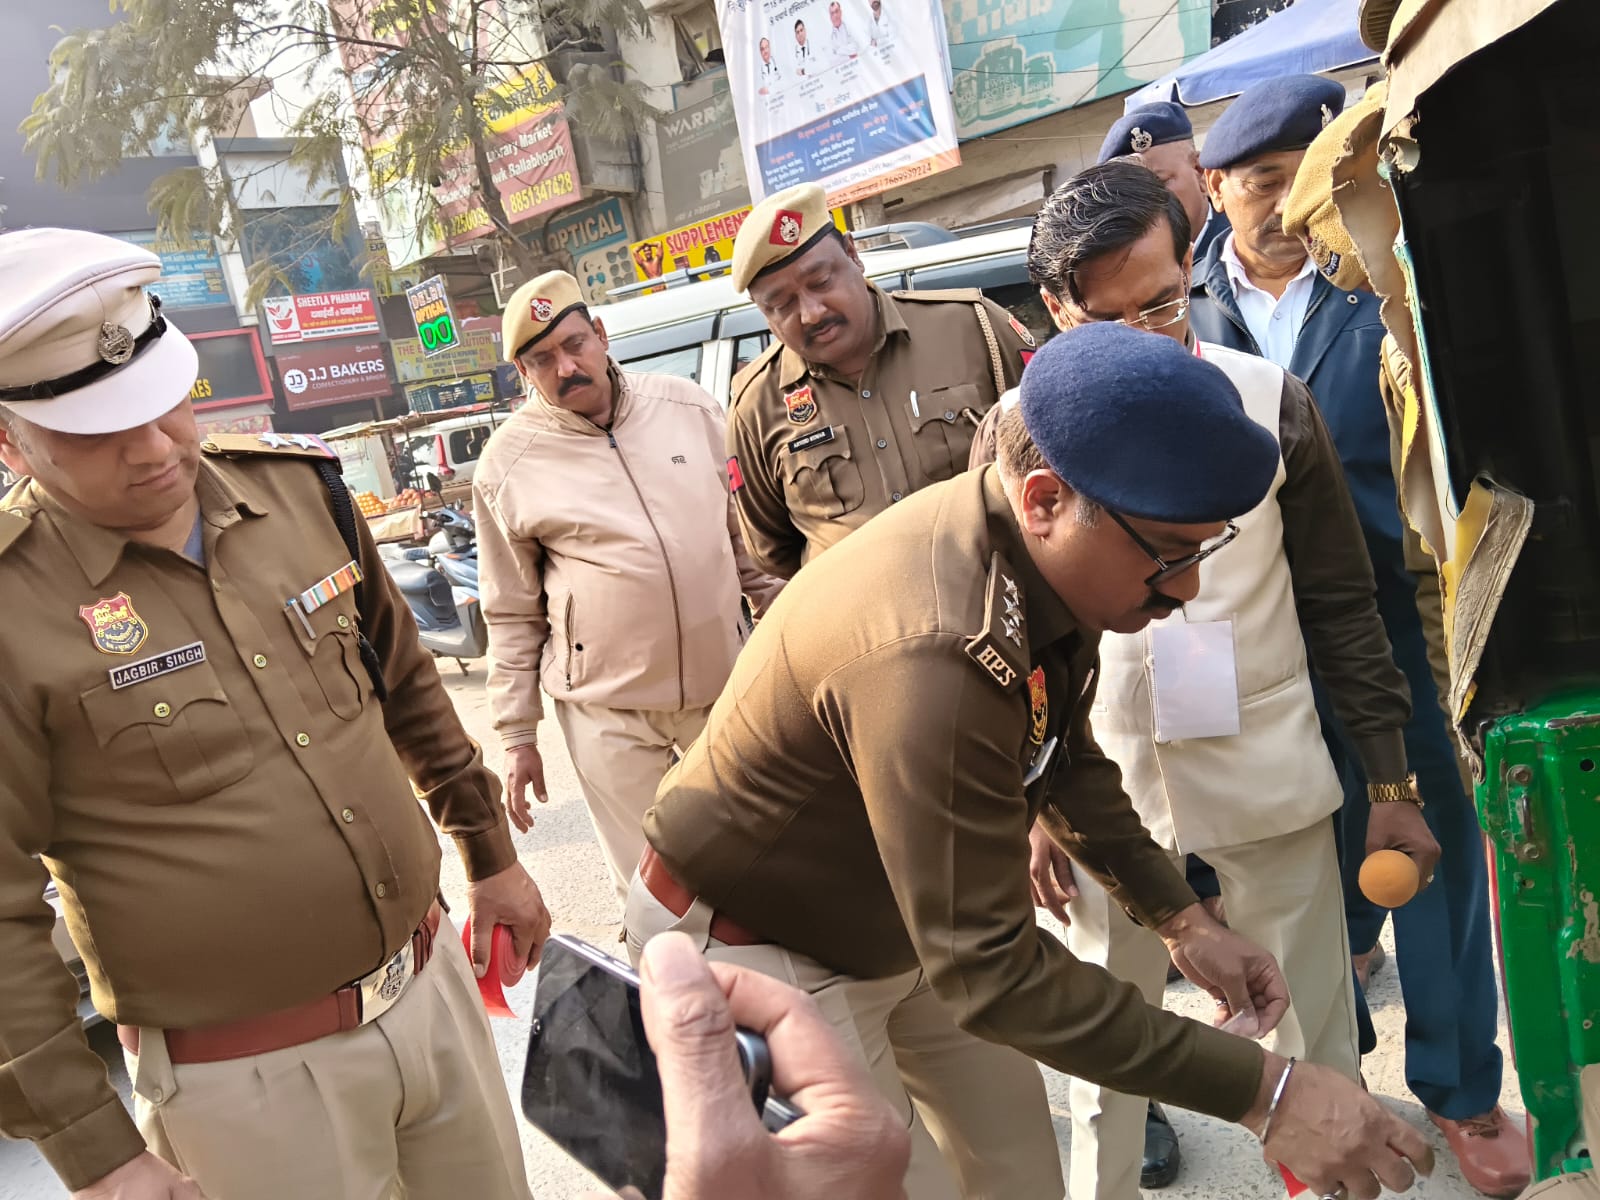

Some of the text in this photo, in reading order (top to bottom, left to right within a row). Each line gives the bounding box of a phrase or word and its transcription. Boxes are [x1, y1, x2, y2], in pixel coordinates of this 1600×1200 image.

[519, 123, 554, 149] Market
[508, 145, 565, 176] Ballabhgarh
[509, 173, 574, 215] 8851347428
[547, 210, 623, 251] OPTICAL
[296, 291, 371, 308] SHEETLA PHARMACY
[411, 283, 443, 310] DELHI
[415, 299, 447, 324] OPTICAL
[397, 345, 416, 356] THE
[307, 359, 386, 381] J.J BAKERS
[116, 648, 203, 685] JAGBIR SINGH
[976, 644, 1017, 687] HPS
